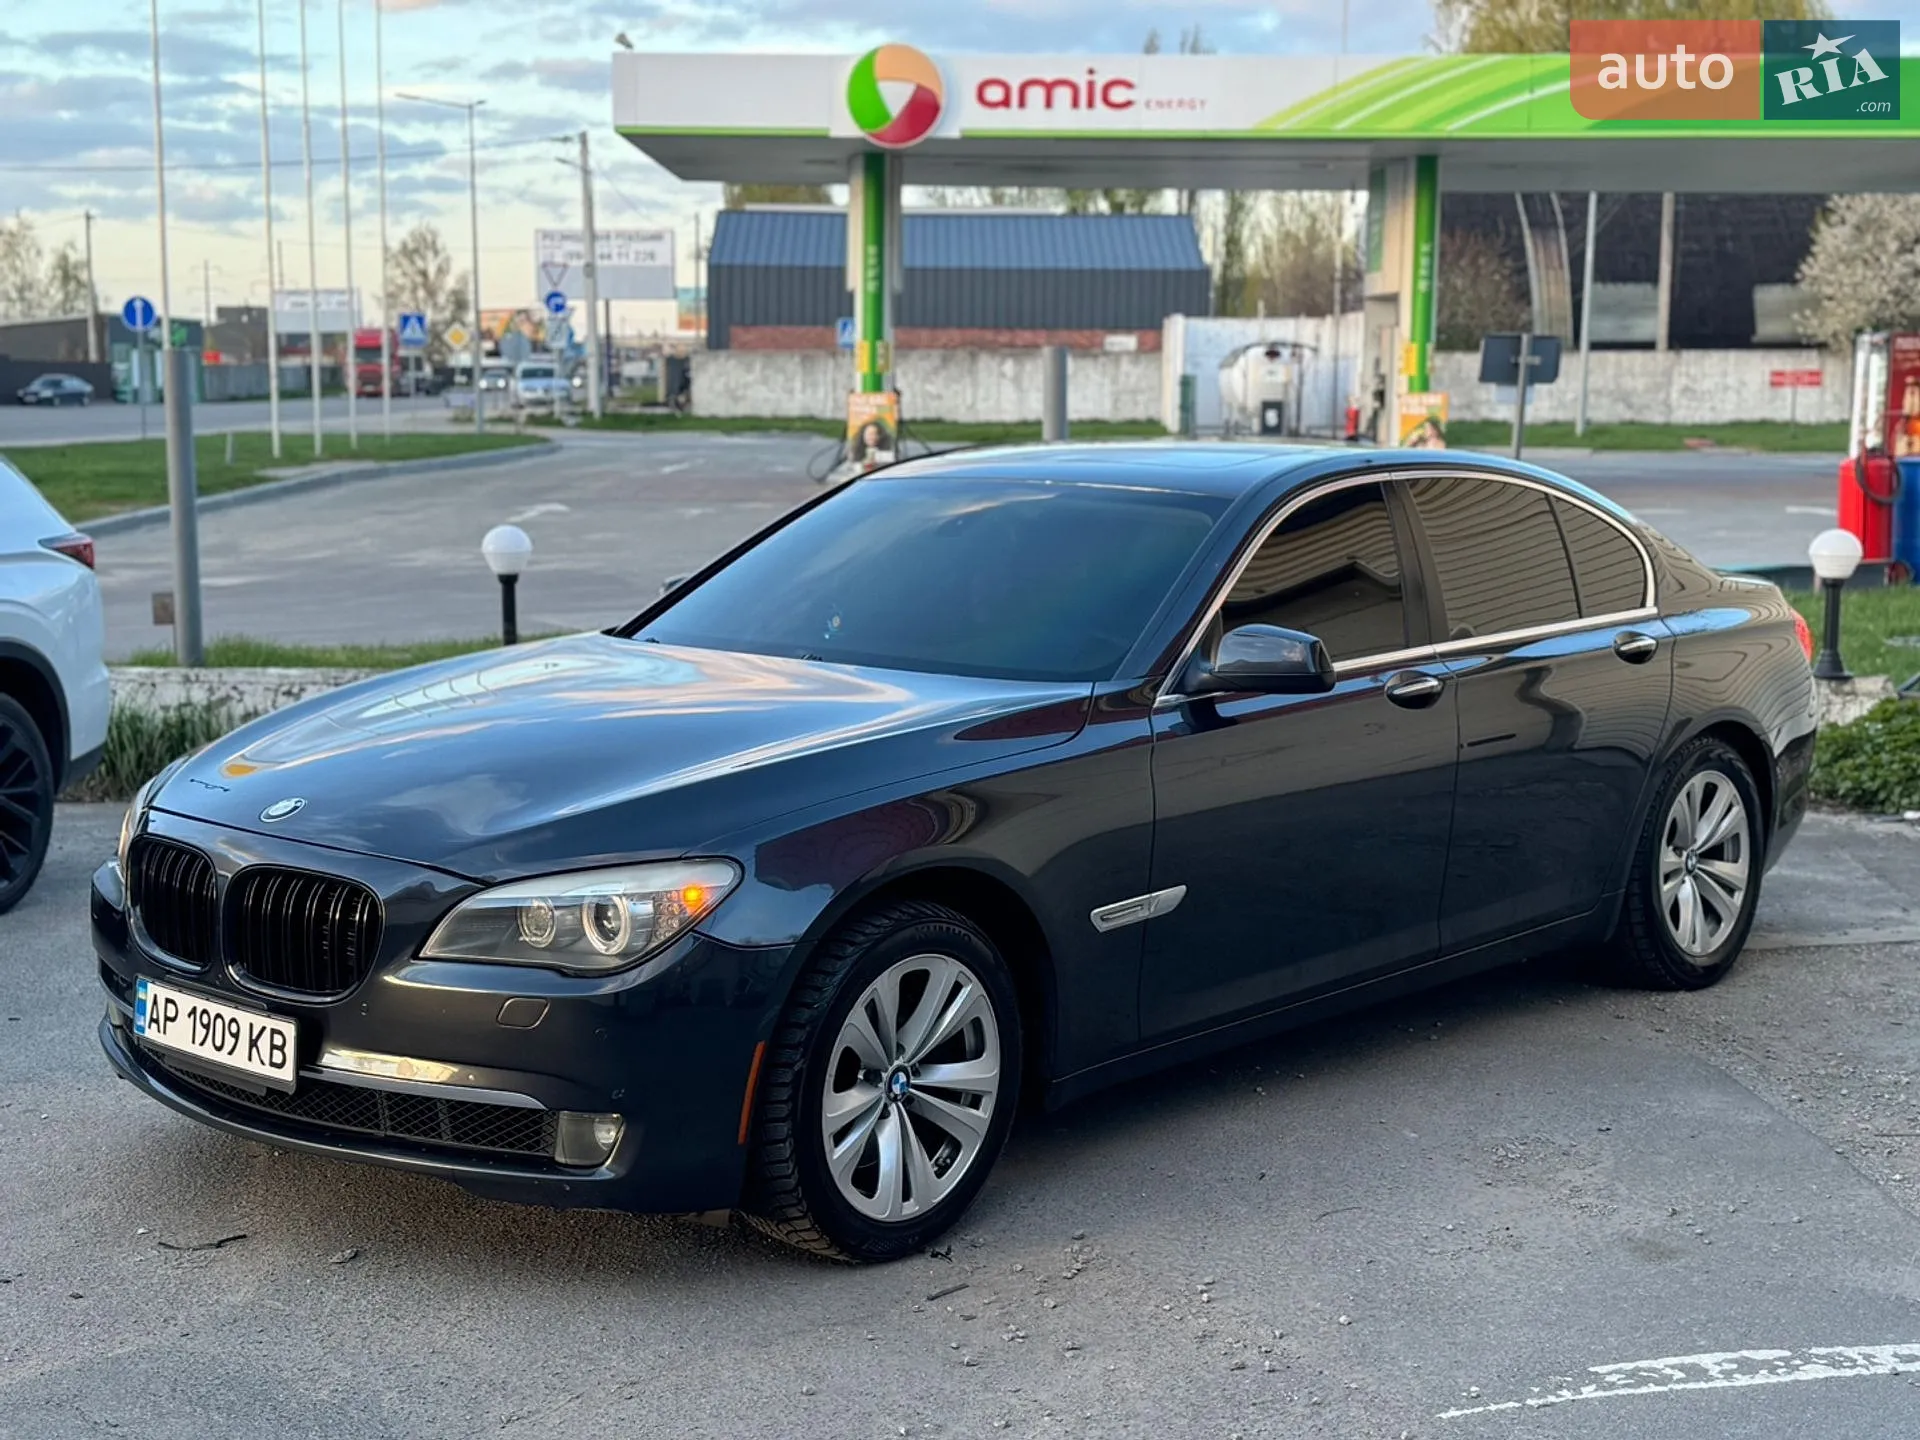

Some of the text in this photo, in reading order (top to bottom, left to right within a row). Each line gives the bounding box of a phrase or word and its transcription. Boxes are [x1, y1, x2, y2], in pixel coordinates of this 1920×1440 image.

[976, 68, 1207, 110] amic ENERGY
[148, 994, 287, 1070] AP 1909 KB
